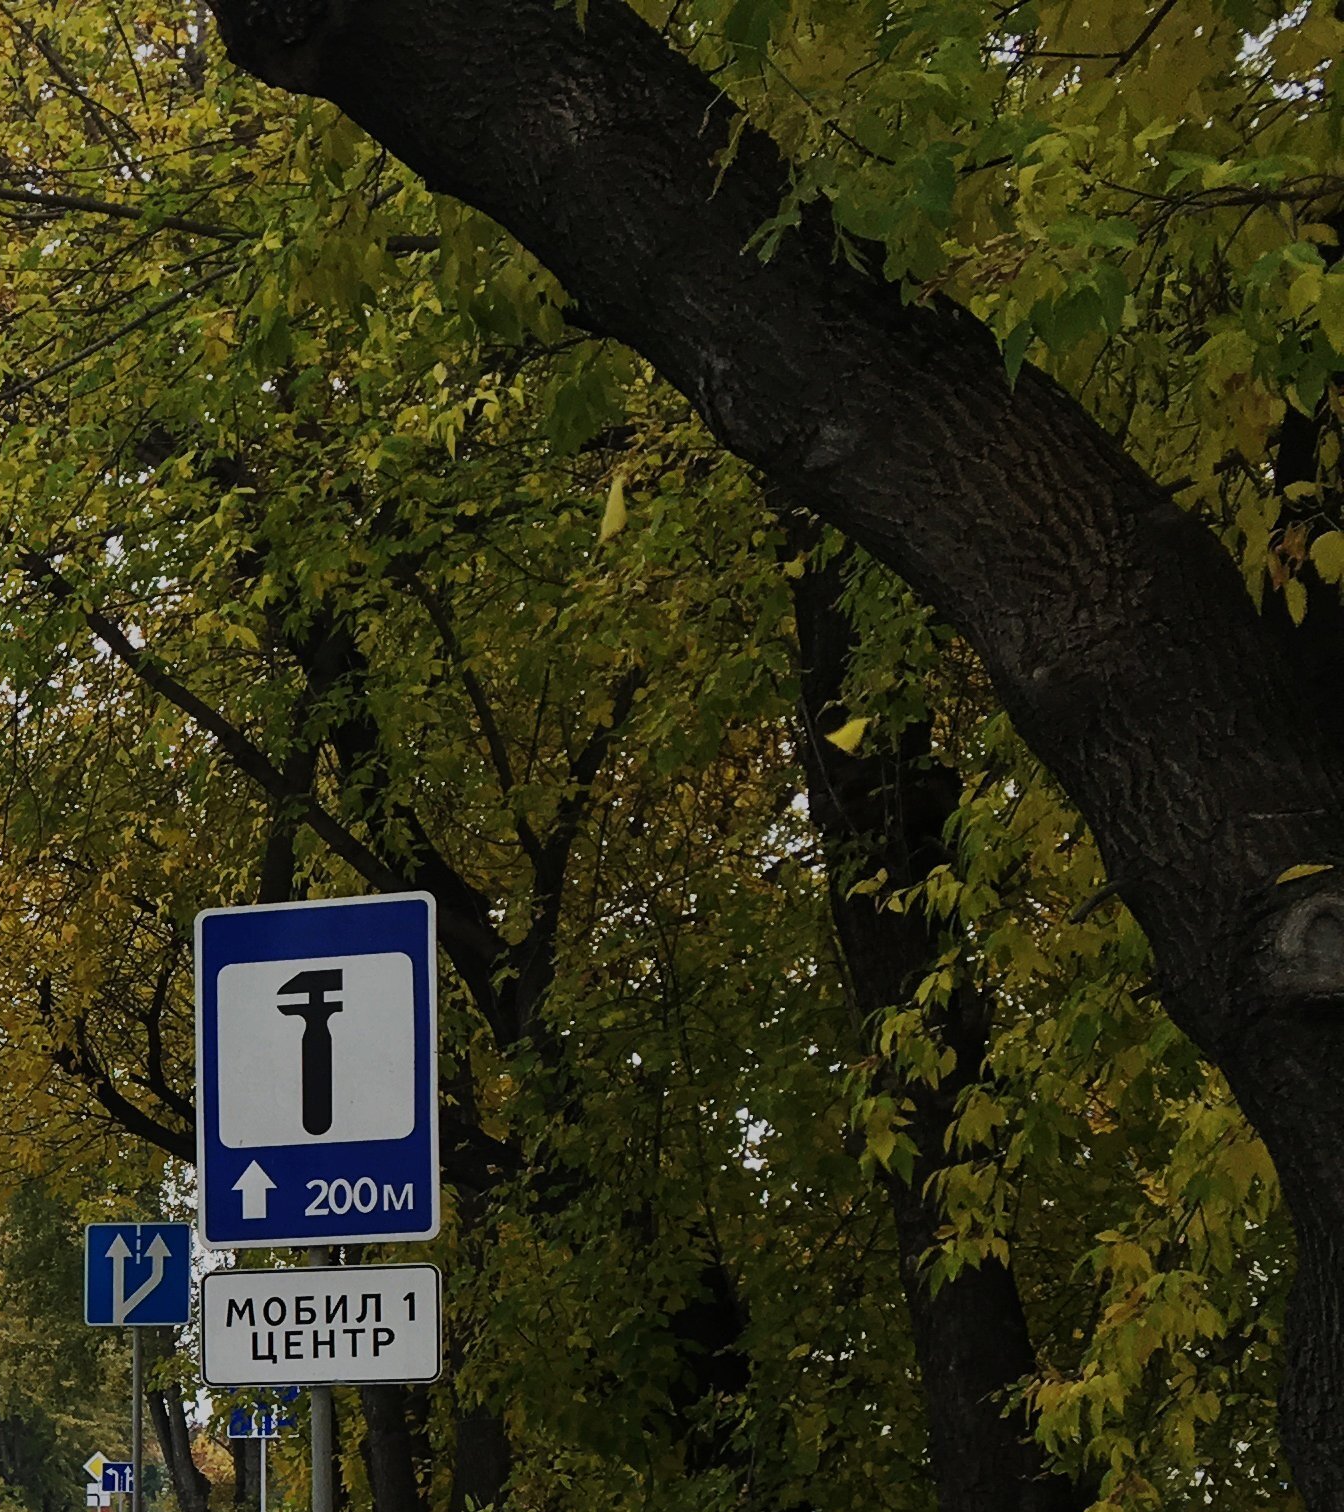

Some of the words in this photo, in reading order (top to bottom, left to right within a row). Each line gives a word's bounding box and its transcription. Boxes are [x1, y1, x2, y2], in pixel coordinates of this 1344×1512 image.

[304, 1176, 378, 1217] 200
[225, 1293, 382, 1328] МОБИЛ
[402, 1291, 416, 1322] 1
[251, 1327, 396, 1365] ЦЕНТР
